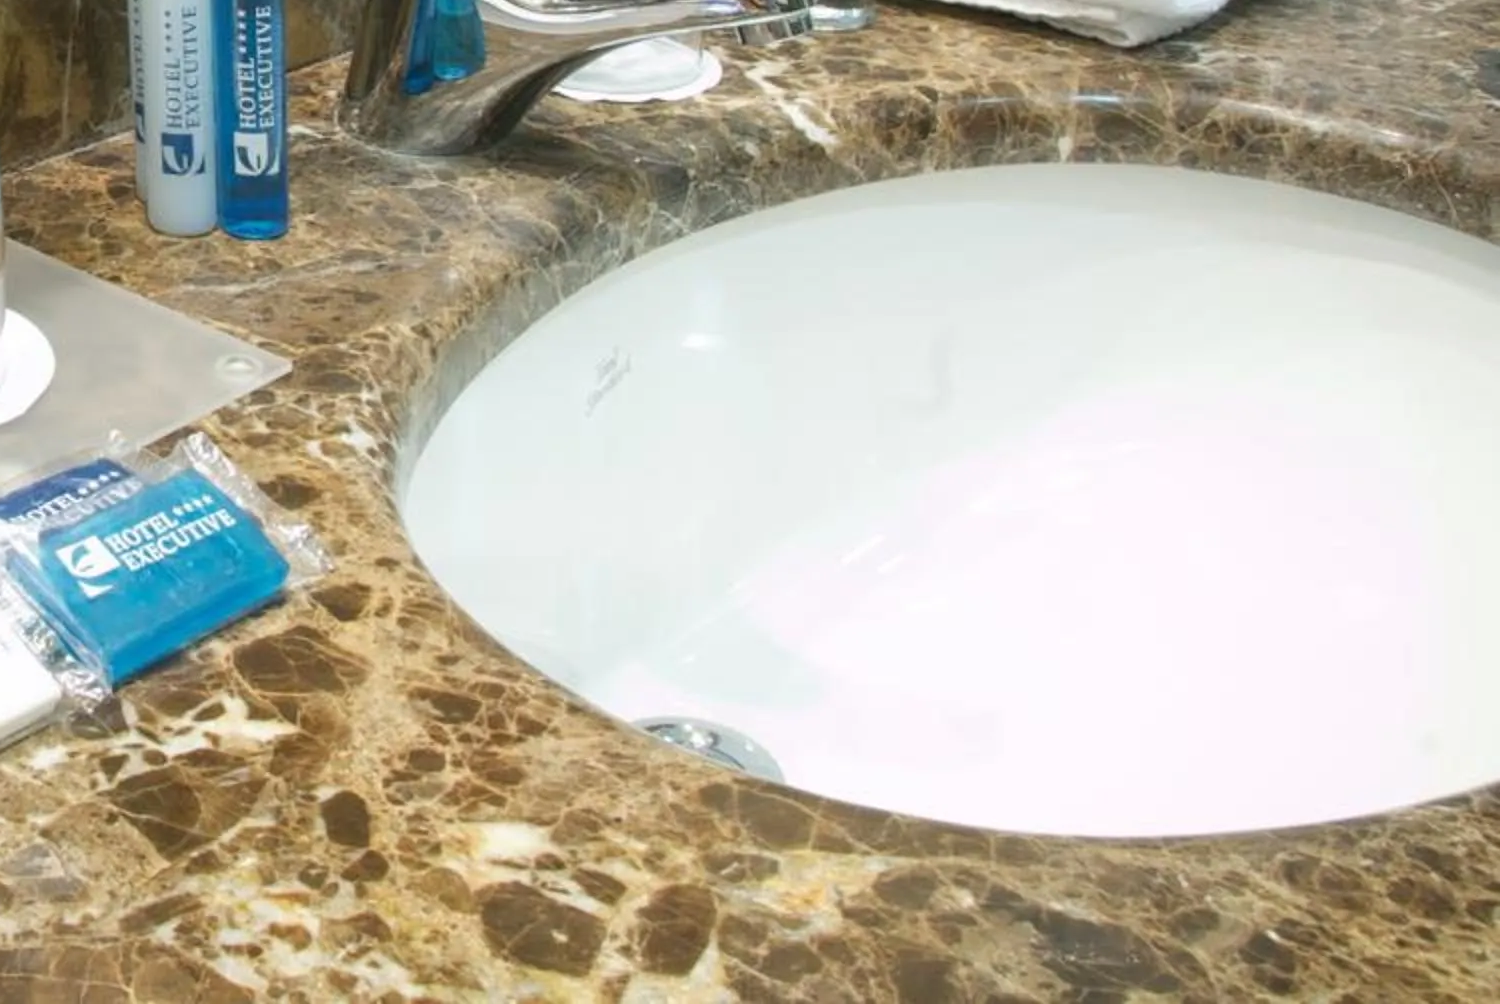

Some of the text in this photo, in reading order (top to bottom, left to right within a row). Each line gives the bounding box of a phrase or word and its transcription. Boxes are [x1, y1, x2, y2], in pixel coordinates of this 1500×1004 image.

[164, 58, 182, 129] HOTEL
[182, 5, 200, 129] EXECUTIVE
[237, 57, 256, 128] HOTEL
[255, 5, 274, 127] EXECUTIVE
[103, 511, 181, 554] HOTEL
[119, 507, 238, 573] EXECUTIVE
